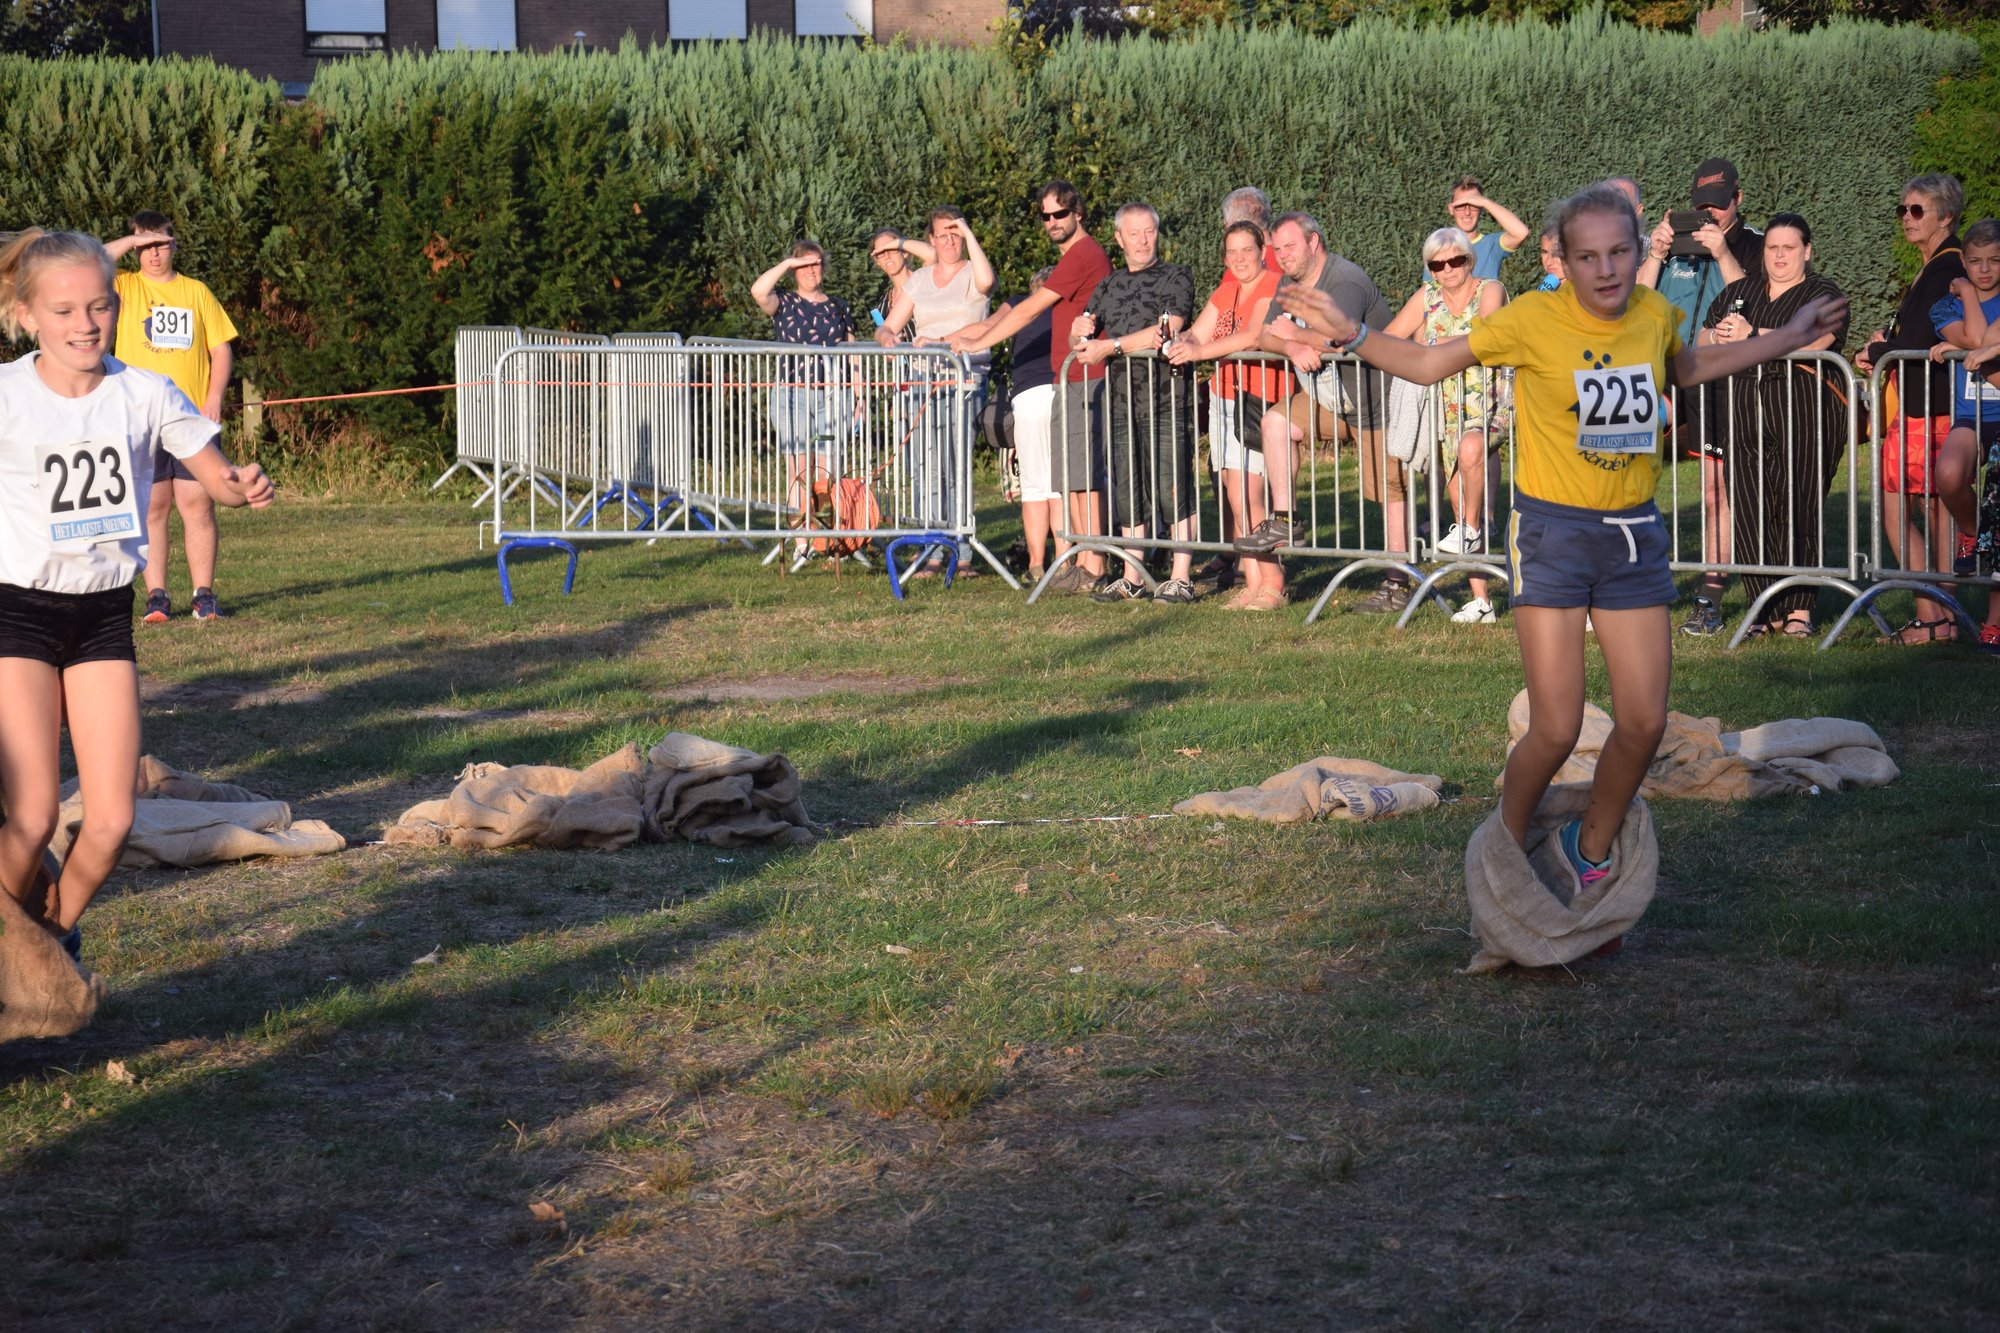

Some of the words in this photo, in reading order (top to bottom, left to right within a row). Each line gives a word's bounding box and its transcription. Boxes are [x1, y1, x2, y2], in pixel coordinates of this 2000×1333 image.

[155, 310, 188, 335] 391
[1583, 373, 1653, 426] 225
[1583, 435, 1597, 446] HET
[1597, 436, 1625, 448] LAATSTE
[1625, 434, 1649, 446] NIEUWS
[44, 446, 126, 513] 223
[54, 523, 71, 540] HET
[71, 520, 102, 538] LAATSTE
[102, 516, 131, 533] NIEUWS
